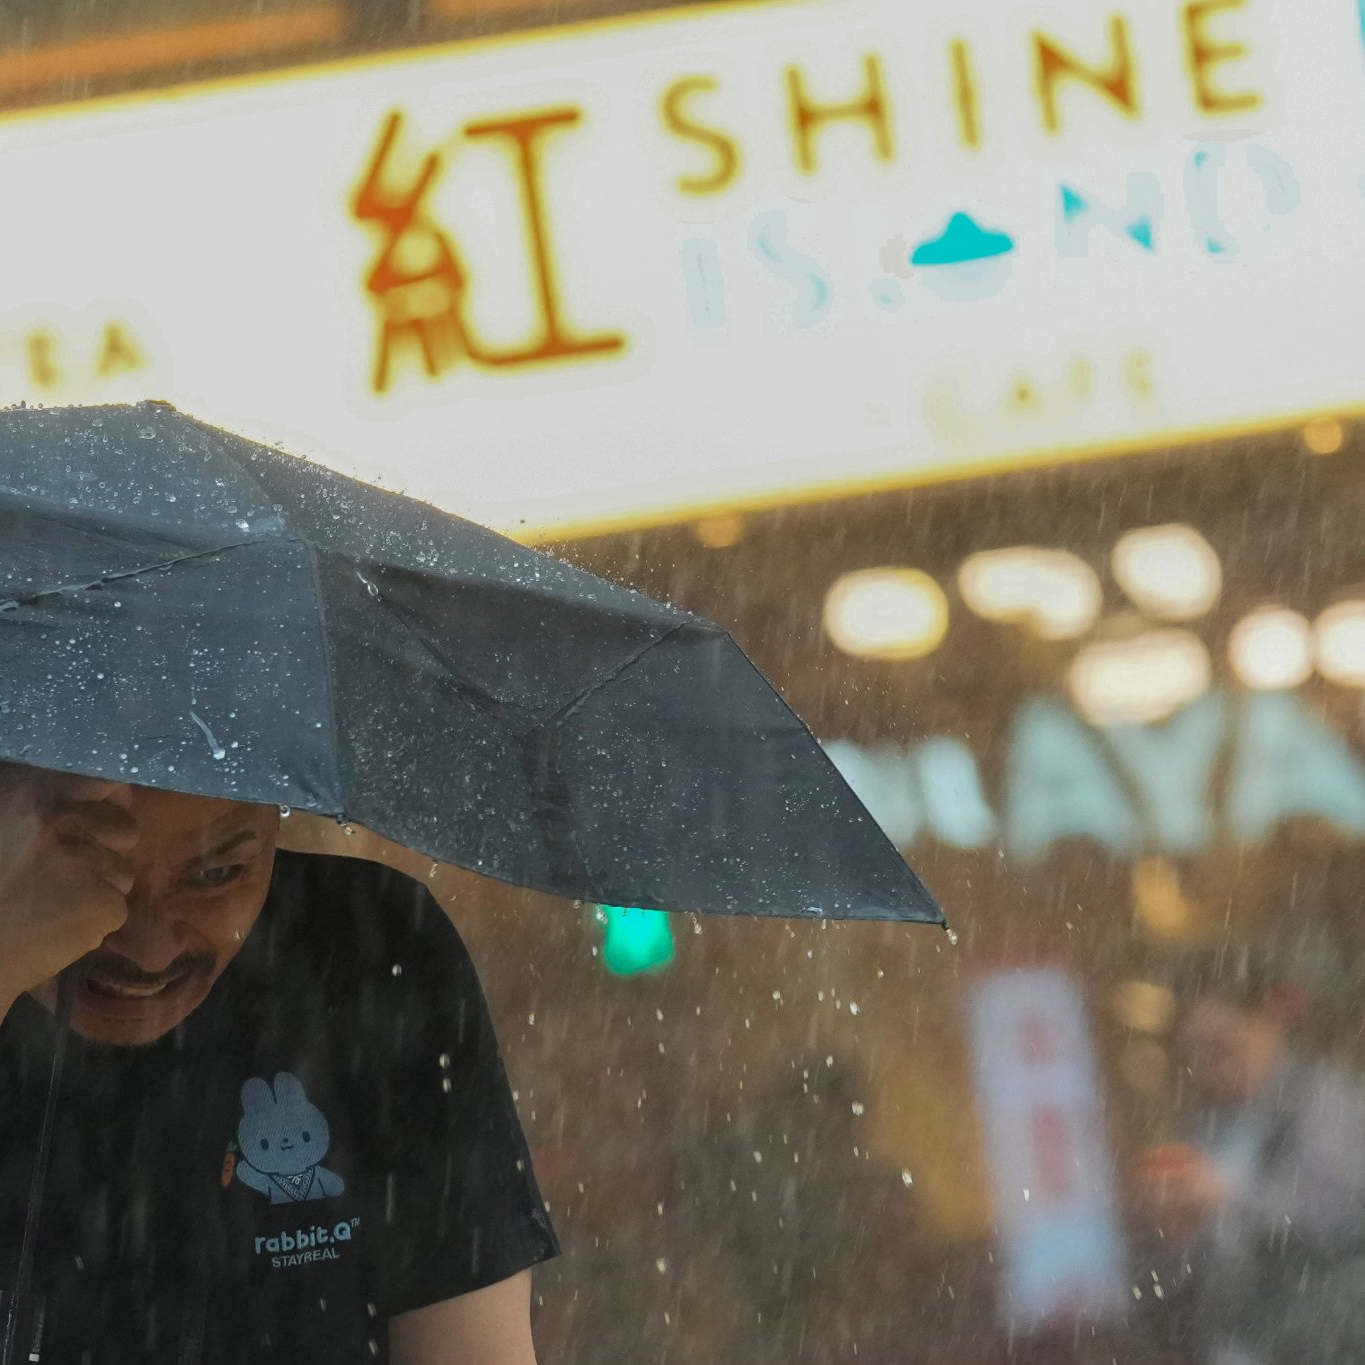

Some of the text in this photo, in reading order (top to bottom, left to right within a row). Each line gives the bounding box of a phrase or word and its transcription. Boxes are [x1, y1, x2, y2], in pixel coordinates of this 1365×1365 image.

[659, 0, 1262, 196] SHINE
[347, 108, 625, 393] 紅
[271, 1247, 341, 1268] STAYREAL
